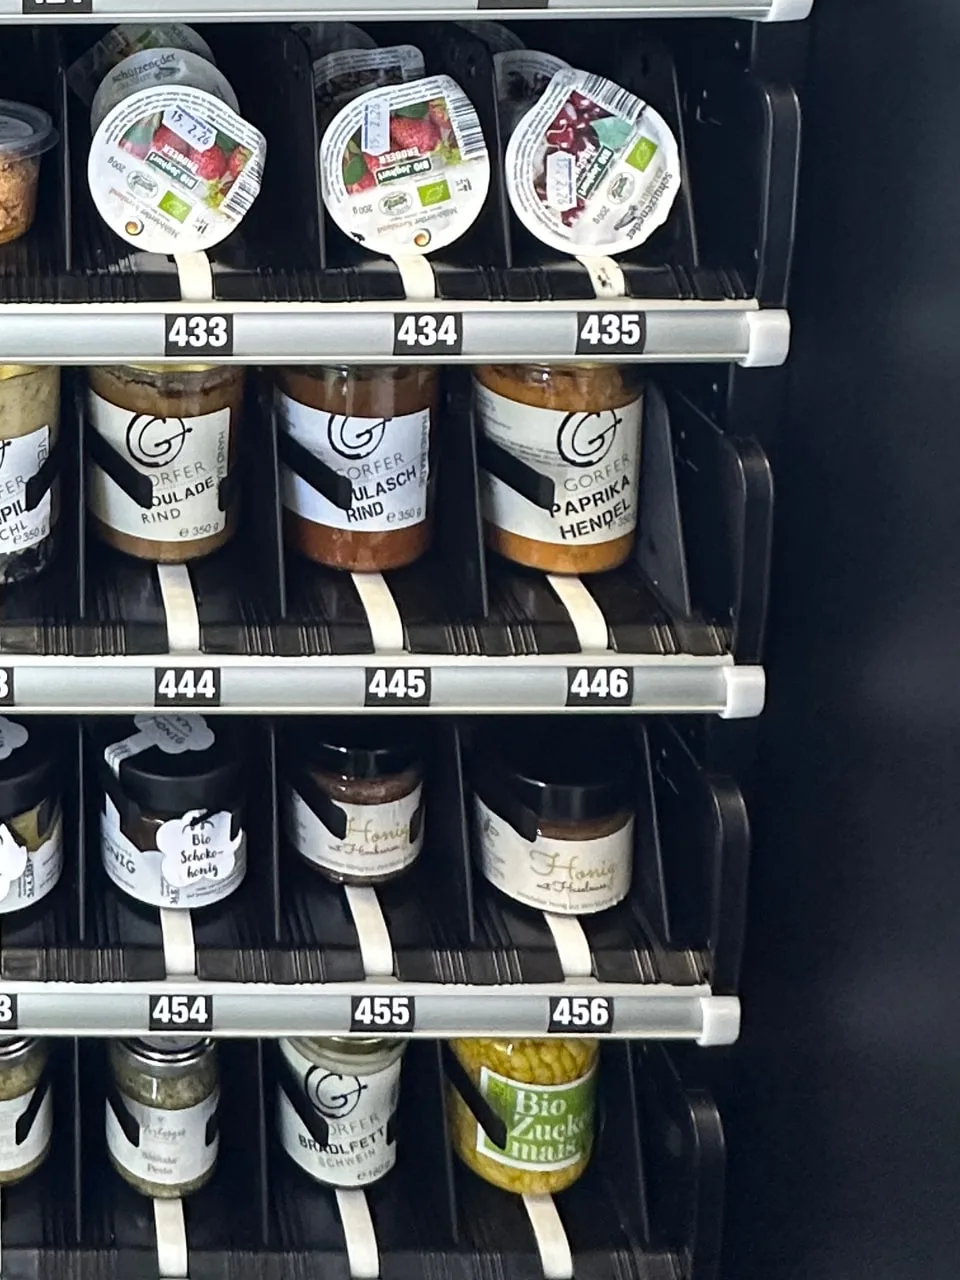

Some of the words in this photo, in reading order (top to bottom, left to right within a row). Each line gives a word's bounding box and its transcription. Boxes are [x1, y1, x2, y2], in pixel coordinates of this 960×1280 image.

[169, 317, 227, 347] 433
[398, 315, 457, 345] 434
[581, 314, 640, 344] 435
[149, 461, 207, 488] ORFER
[351, 465, 417, 501] ULASCH
[563, 452, 630, 492] GORFER
[152, 477, 214, 507] OULADE
[549, 475, 631, 518] PAPRIKA
[141, 508, 181, 524] RIND
[345, 501, 384, 523] RIND
[398, 508, 415, 521] 350
[560, 499, 631, 539] HENDEL
[23, 529, 40, 542] 350
[192, 524, 211, 535] 350
[159, 670, 215, 698] 444
[369, 669, 425, 698] 445
[571, 669, 628, 697] 446
[192, 833, 212, 846] Bio
[180, 848, 224, 864] Schoko-
[529, 850, 615, 886] Honig
[187, 863, 218, 879] honig
[153, 996, 208, 1023] 454
[355, 997, 409, 1024] 455
[553, 998, 608, 1025] 456
[516, 1090, 566, 1116] Bio
[511, 1140, 576, 1162] mais
